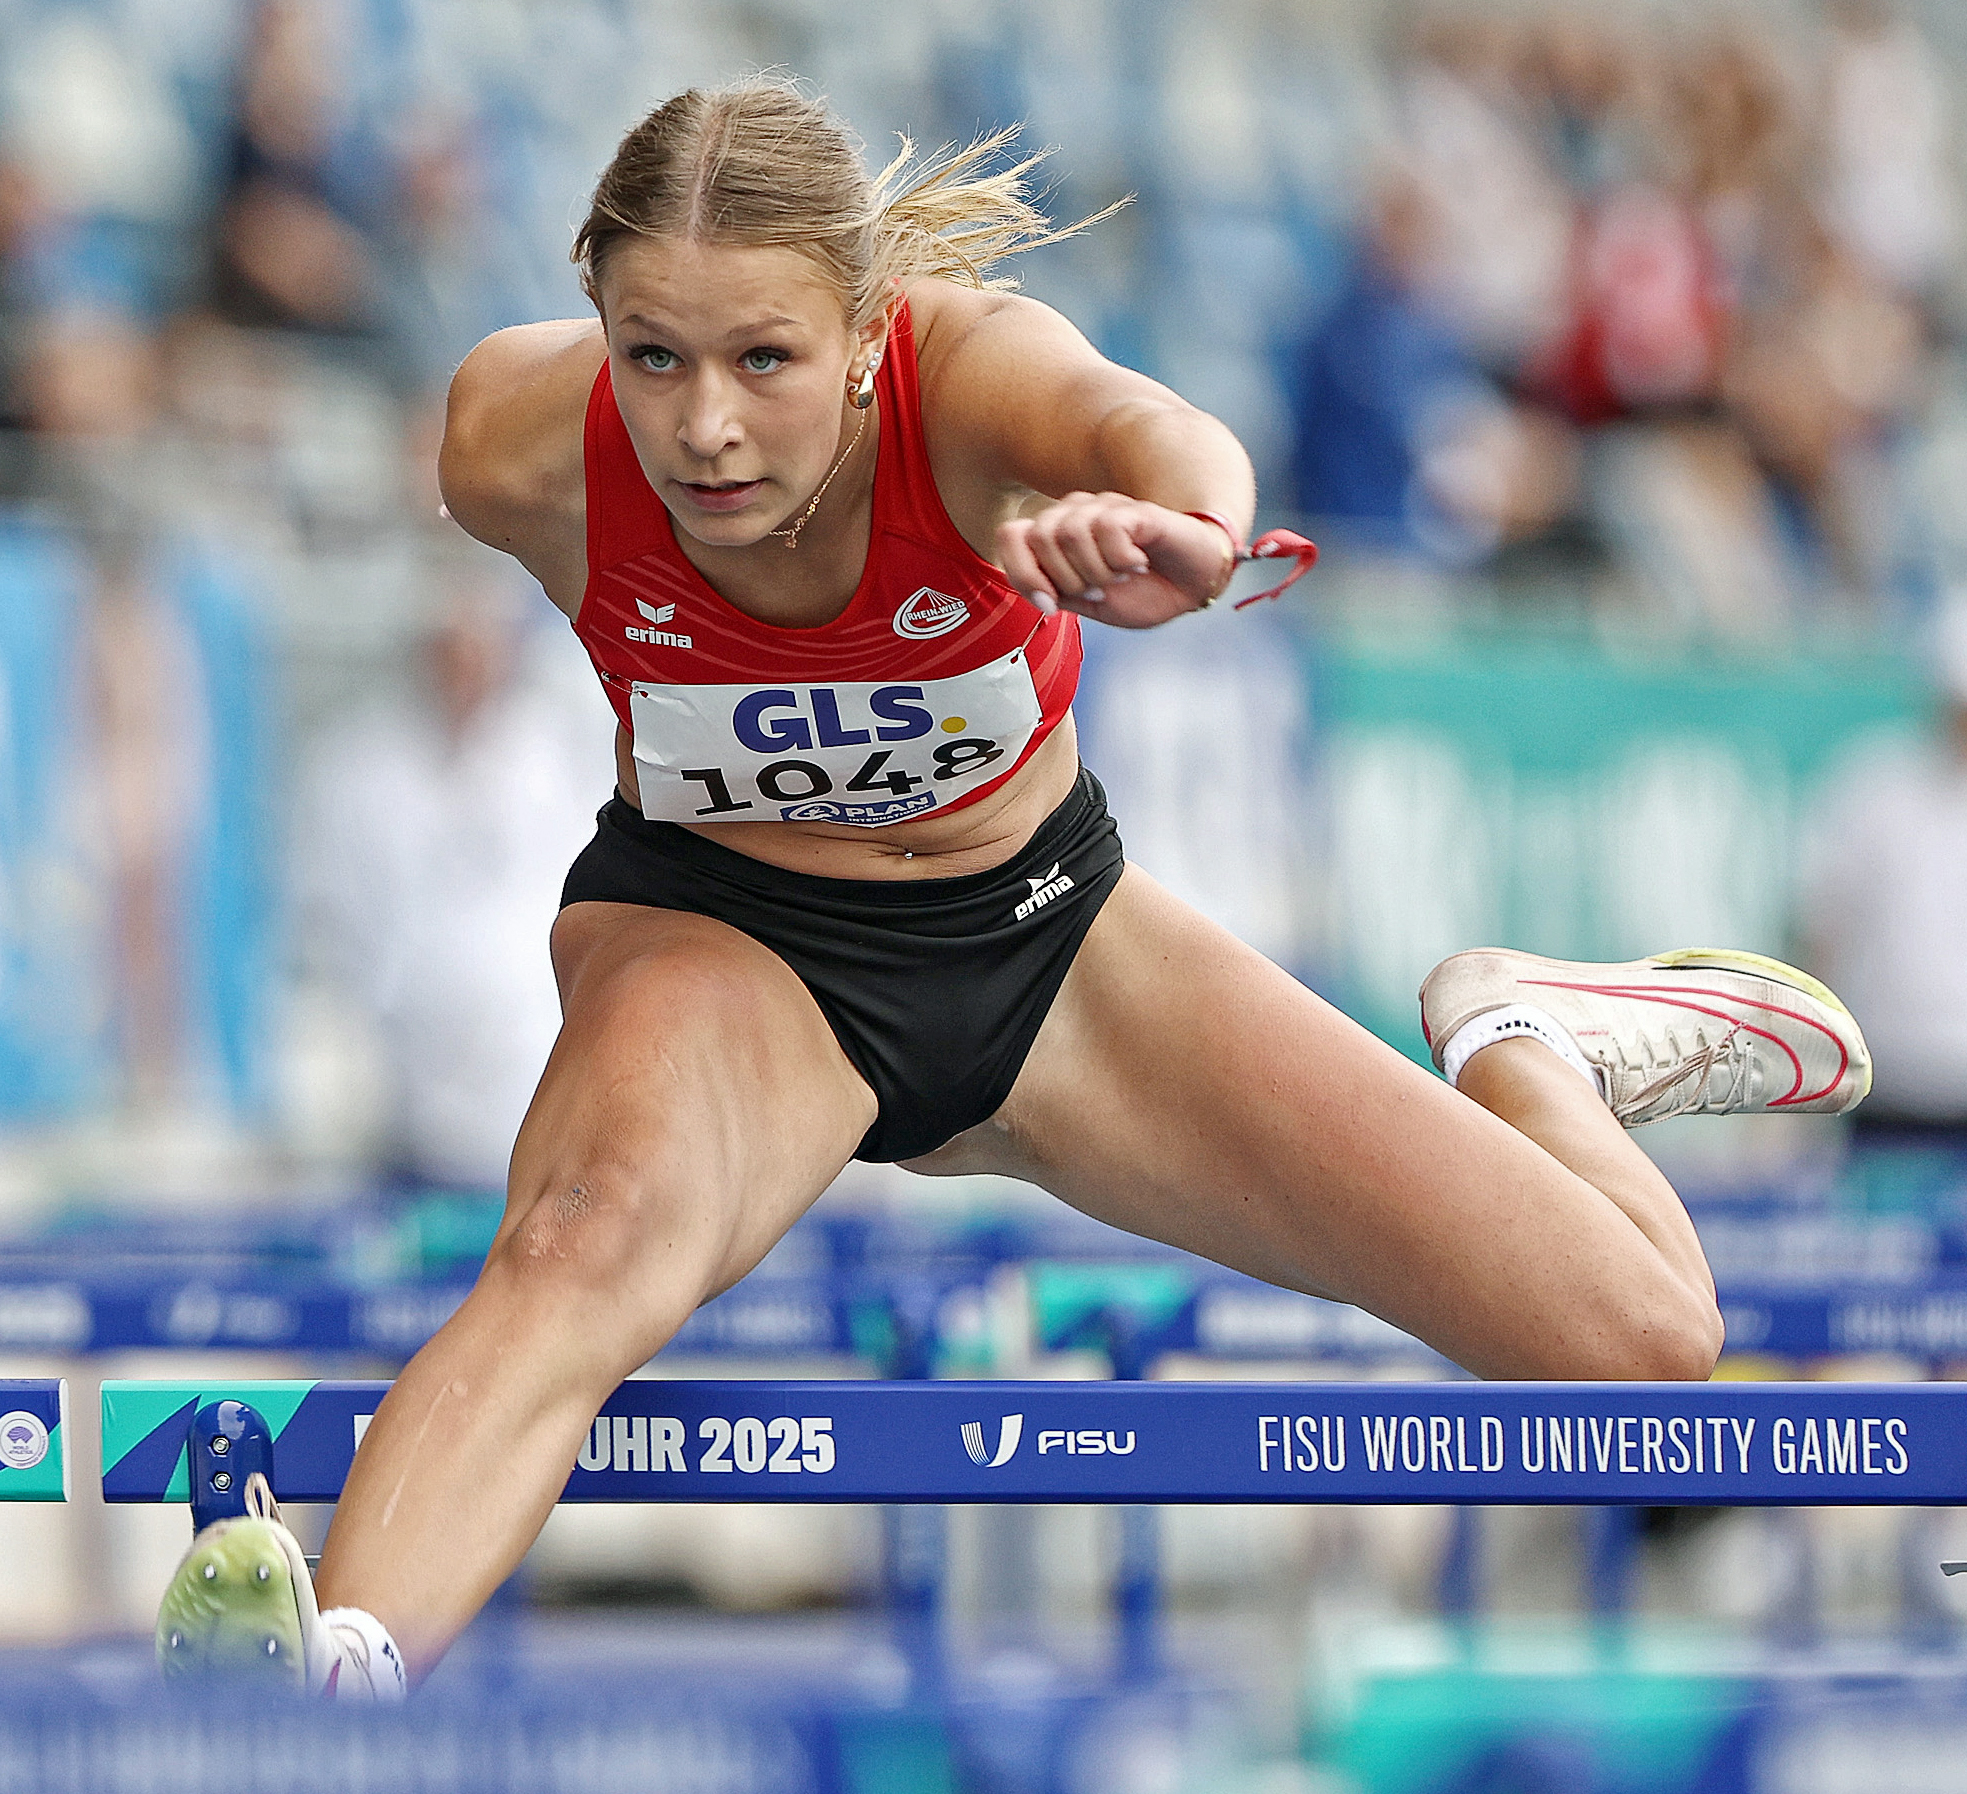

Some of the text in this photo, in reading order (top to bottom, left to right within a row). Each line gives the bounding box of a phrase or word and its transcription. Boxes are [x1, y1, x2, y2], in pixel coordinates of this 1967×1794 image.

[625, 626, 693, 649] erima
[681, 738, 1005, 816] 1048
[844, 796, 929, 817] PLAN
[848, 804, 931, 822] INTERNATIONAL
[1014, 875, 1076, 921] erima
[699, 1416, 836, 1473] 2025
[1037, 1429, 1136, 1455] FISU
[1257, 1415, 1909, 1475] FISU WORLD UNIVERSITY GAMES
